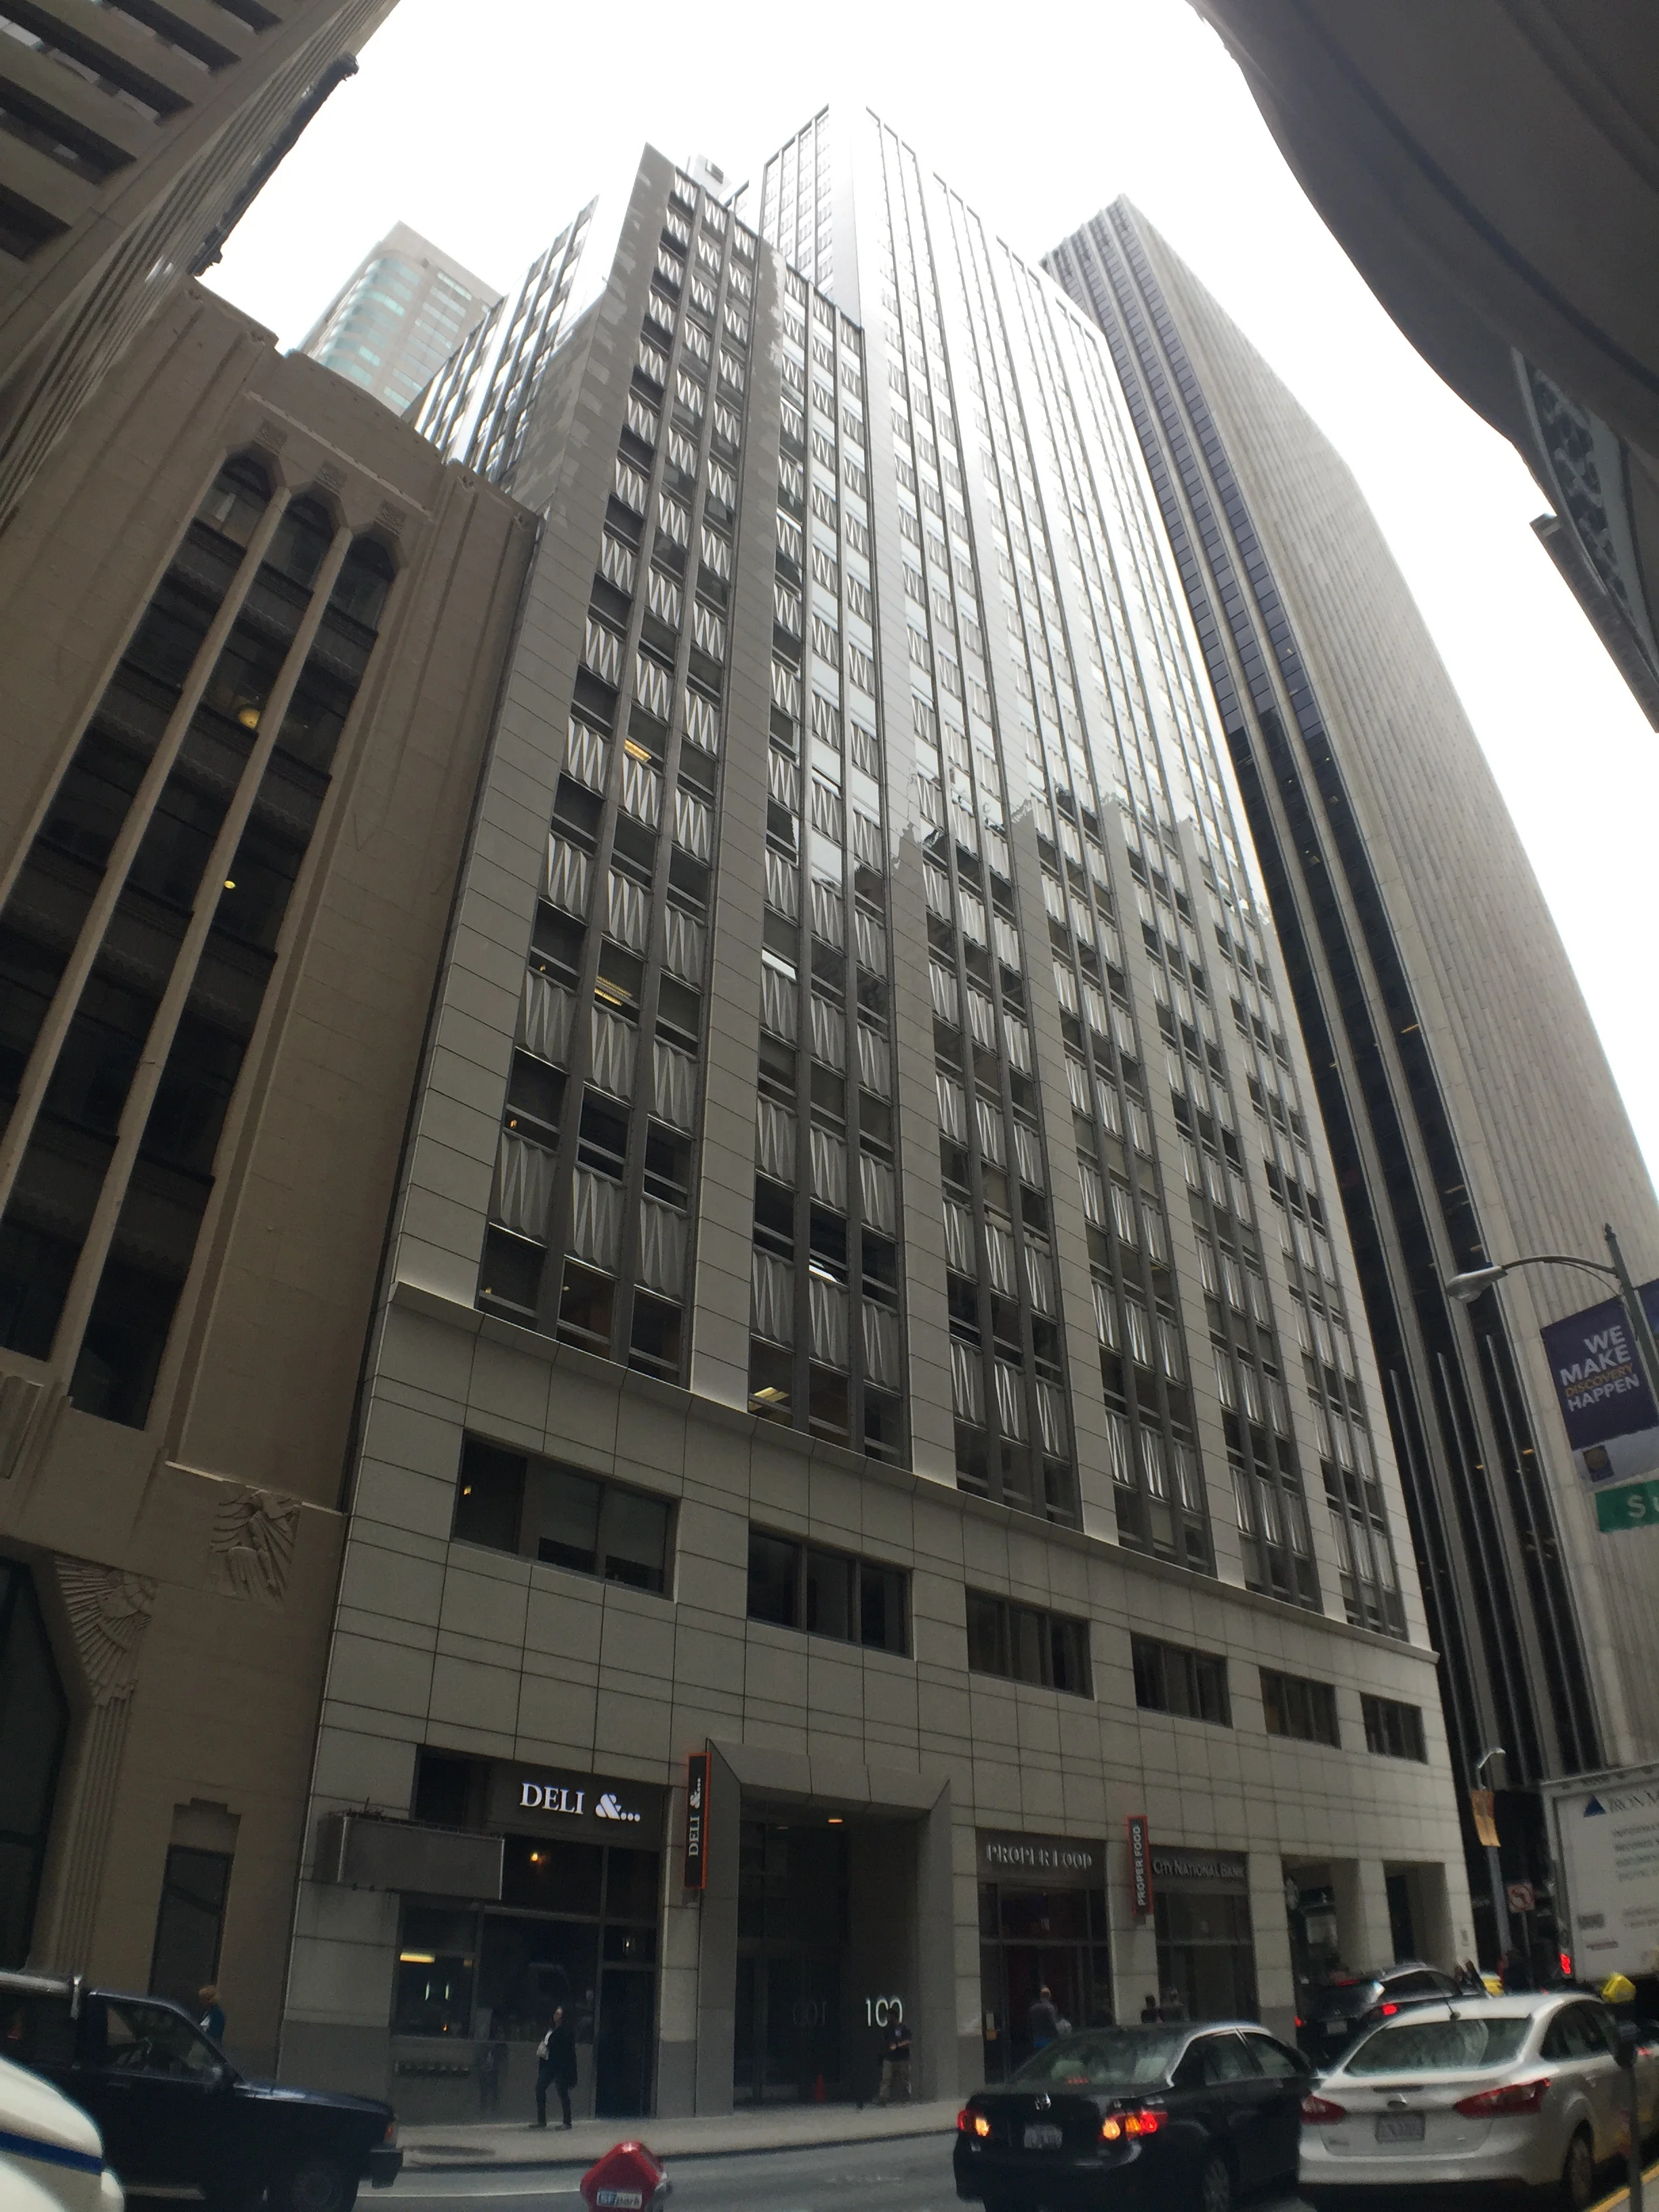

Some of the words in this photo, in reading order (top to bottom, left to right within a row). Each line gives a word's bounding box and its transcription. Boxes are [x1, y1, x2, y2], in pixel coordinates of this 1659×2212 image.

[1583, 1325, 1625, 1354] WE
[1560, 1344, 1631, 1386] MAKE
[1565, 1363, 1633, 1398] DISCOVERY
[1567, 1373, 1640, 1412] HAPPEN
[519, 1782, 585, 1815] DELI
[689, 1815, 700, 1857] DELI
[1132, 1824, 1143, 1857] FOOD
[1135, 1859, 1147, 1906] PROPER
